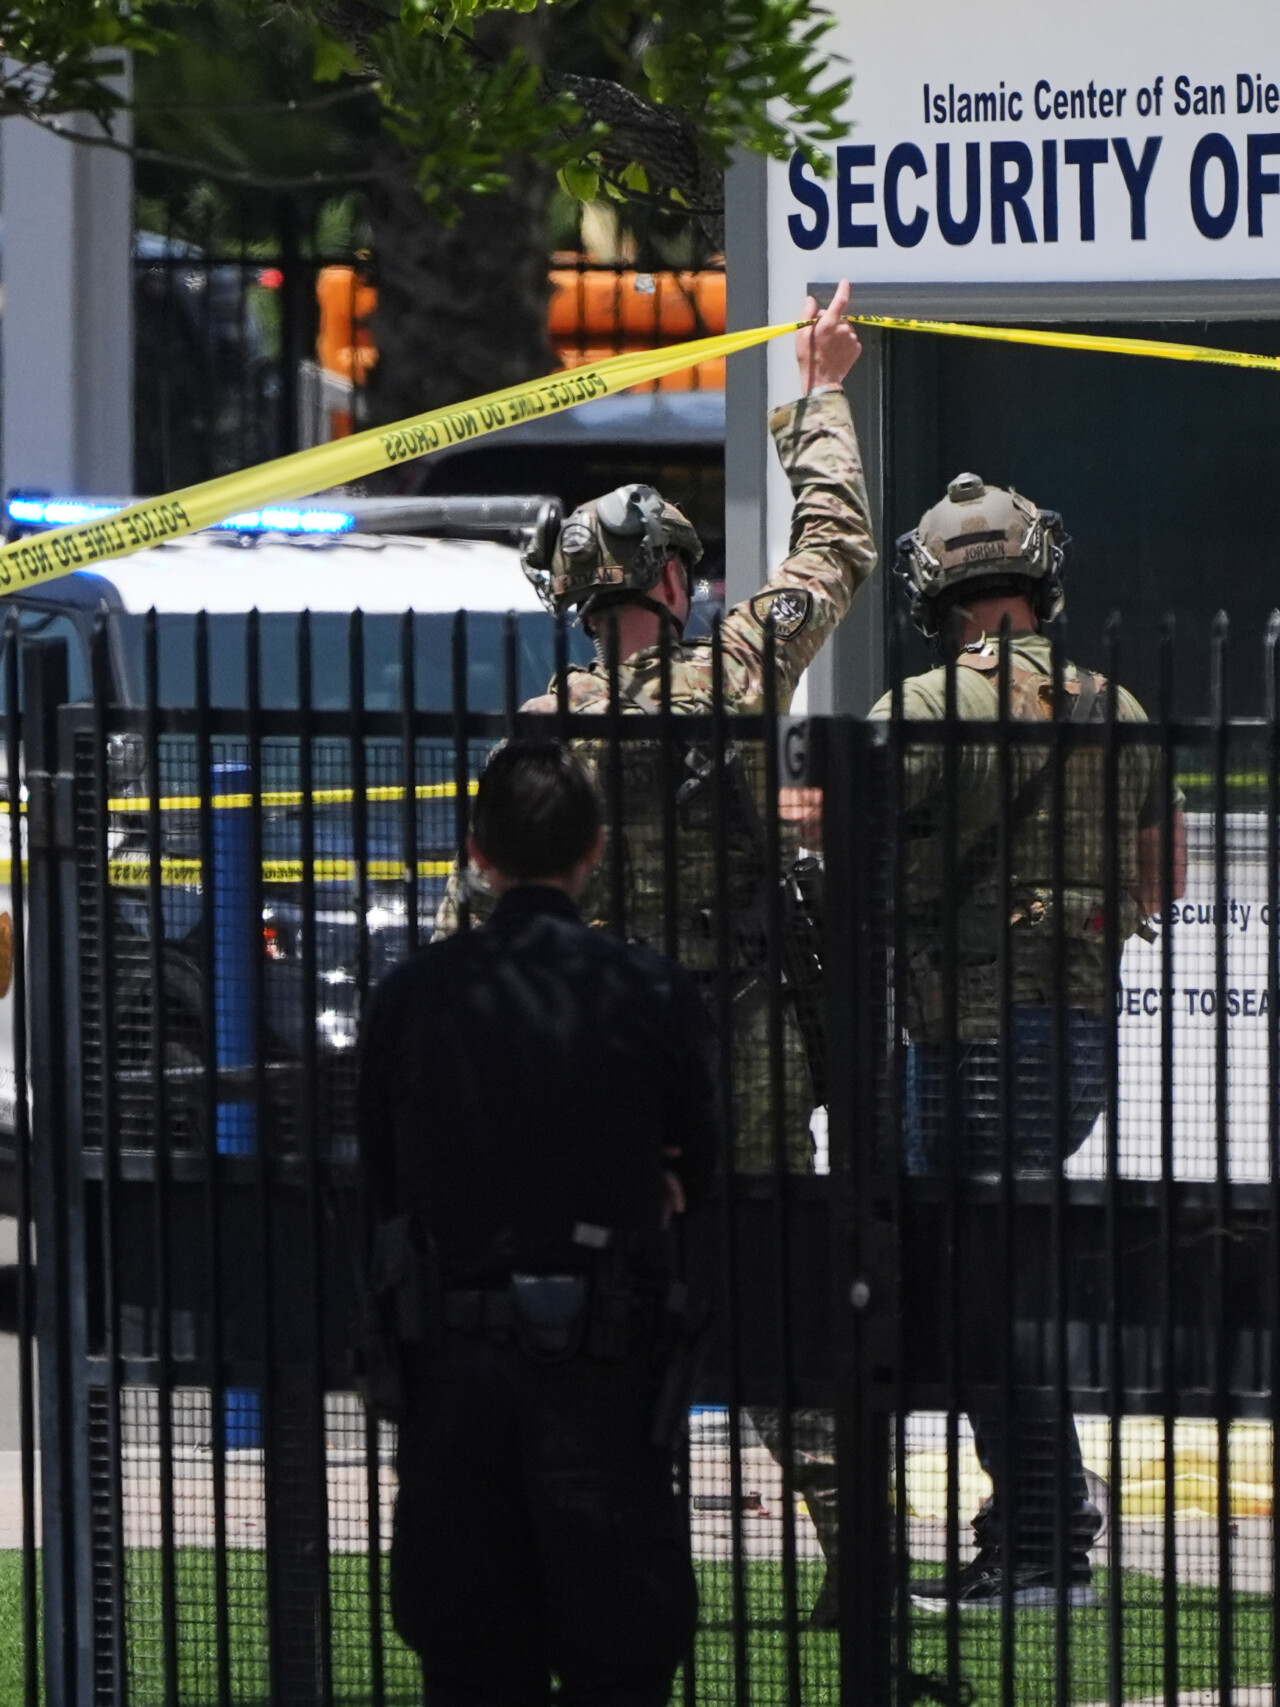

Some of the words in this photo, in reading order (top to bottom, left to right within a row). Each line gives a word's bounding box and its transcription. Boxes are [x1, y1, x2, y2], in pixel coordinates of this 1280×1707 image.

[923, 81, 1023, 125] Islamic
[1034, 79, 1127, 121] Center
[1136, 75, 1164, 117] of
[1173, 75, 1226, 116] San
[787, 136, 1162, 251] SECURITY
[963, 542, 1005, 560] JORDAN
[1183, 988, 1218, 1016] TO
